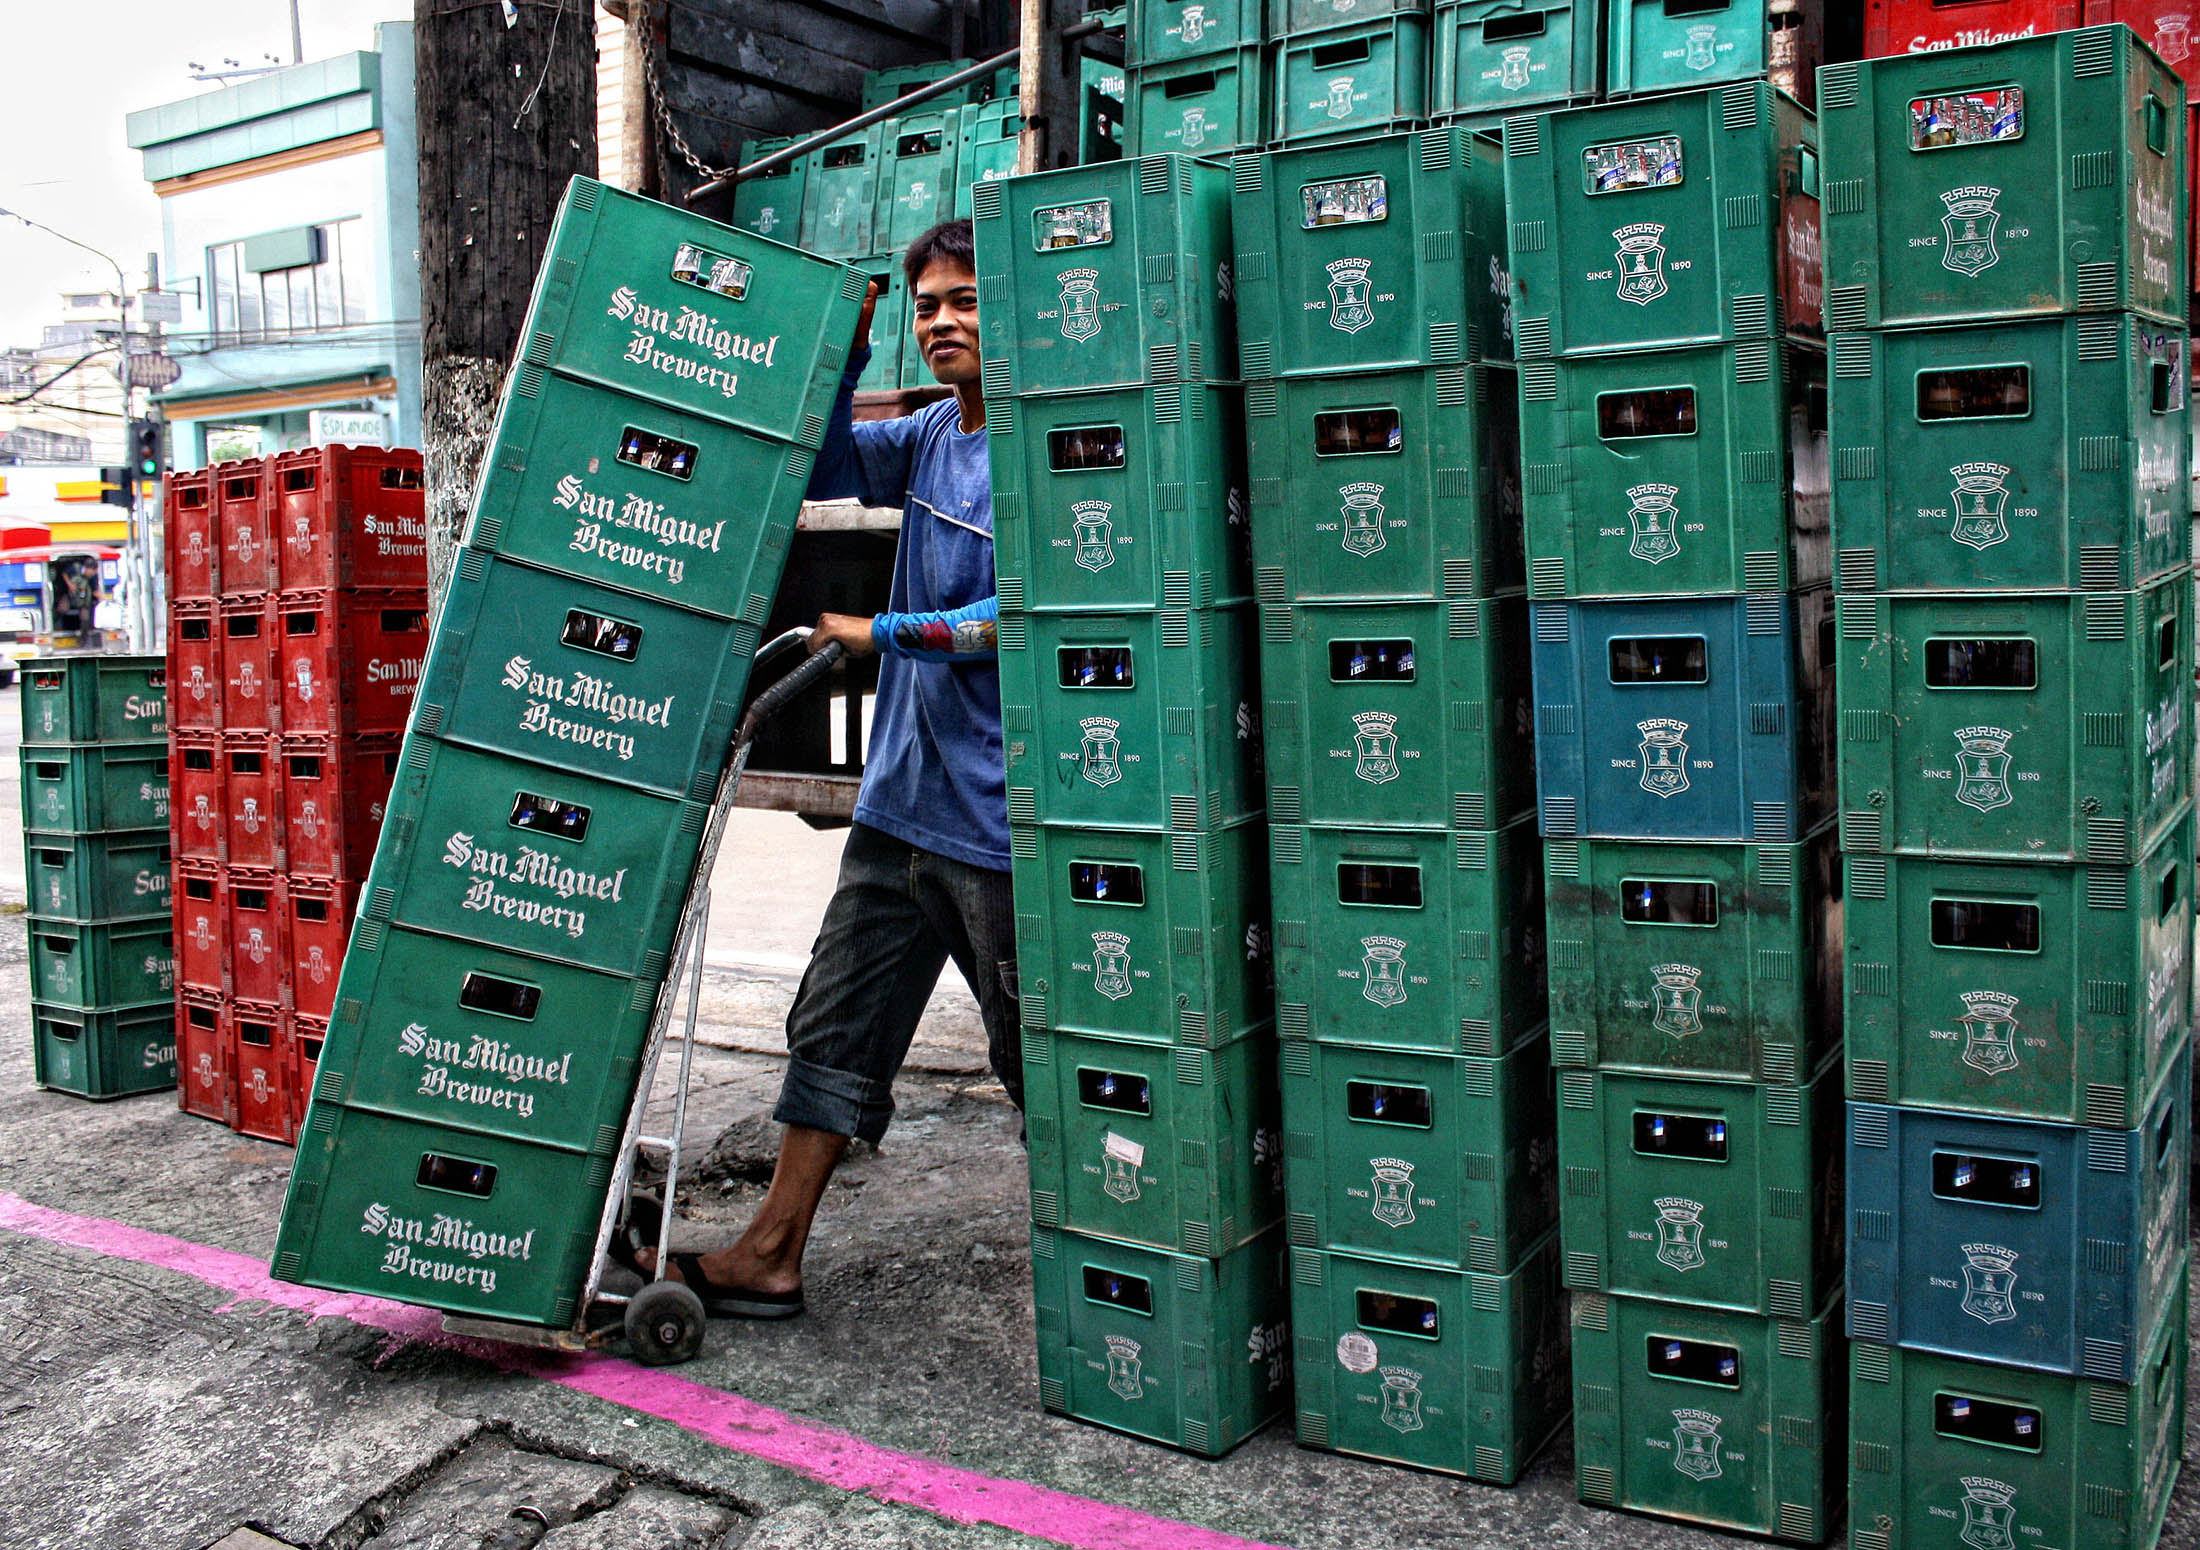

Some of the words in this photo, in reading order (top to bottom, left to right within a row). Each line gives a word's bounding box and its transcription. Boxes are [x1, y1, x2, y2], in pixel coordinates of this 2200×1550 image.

[1908, 236, 1938, 248] SINCE
[1586, 269, 1613, 281] SINCE
[1670, 260, 1692, 271] 1890
[1303, 300, 1327, 311] SINCE
[1376, 293, 1395, 303] 1890
[1037, 309, 1059, 320] SINCE
[608, 286, 668, 334] San
[671, 306, 779, 367] Miguel
[625, 331, 737, 398] Brewery
[554, 475, 613, 521] San
[616, 493, 725, 552] Miguel
[1917, 508, 1947, 518] SINCE
[2014, 508, 2038, 517] 1890
[364, 513, 394, 535] San
[1315, 522, 1339, 531] SINCE
[1389, 519, 1408, 528] 1890
[1599, 527, 1626, 537] SINCE
[1683, 523, 1705, 532] 1890
[377, 536, 426, 557] Brewer
[570, 519, 683, 583] Brewery
[1051, 538, 1072, 547] SINCE
[1116, 536, 1133, 545] 1890
[367, 658, 400, 682] San
[390, 684, 416, 695] BREW
[502, 656, 562, 700] San
[565, 672, 674, 727] Miguel
[123, 695, 162, 721] San
[520, 700, 634, 760] Brewery
[1059, 751, 1080, 761] SINCE
[1123, 754, 1141, 762] 1890
[1329, 749, 1352, 758] SINCE
[1402, 750, 1421, 759] 1890
[1611, 759, 1637, 769] SINCE
[1693, 760, 1714, 769] 1890
[1922, 769, 1952, 779] SINCE
[2017, 772, 2041, 782] 1890
[443, 832, 507, 877] San
[510, 847, 626, 902] Miguel
[462, 878, 584, 937] Brewery
[1071, 962, 1092, 972] SINCE
[1134, 969, 1151, 979] 1890
[1337, 969, 1360, 979] SINCE
[1409, 975, 1428, 985] 1890
[1623, 999, 1650, 1009] SINCE
[1706, 1004, 1727, 1015] 1890
[1929, 1030, 1959, 1041] SINCE
[2023, 1037, 2047, 1048] 1890
[399, 1023, 461, 1064] San
[464, 1036, 572, 1084] Miguel
[419, 1067, 533, 1117] Brewery
[1082, 1163, 1101, 1175] SINCE
[1347, 1187, 1369, 1198] SINCE
[1418, 1197, 1436, 1207] 1890
[362, 1203, 423, 1240] San
[425, 1216, 535, 1260] Miguel
[1628, 1230, 1654, 1241] SINCE
[1708, 1239, 1729, 1249] 1890
[381, 1244, 496, 1293] Brewery
[1929, 1276, 1958, 1289] SINCE
[2021, 1290, 2045, 1302] 1890
[1086, 1359, 1106, 1372] SINCE
[1356, 1393, 1379, 1405] SINCE
[1646, 1437, 1671, 1450] SINCE
[1725, 1451, 1746, 1462] 1890
[1928, 1505, 1958, 1520] SINCE
[2020, 1525, 2043, 1537] 1890
